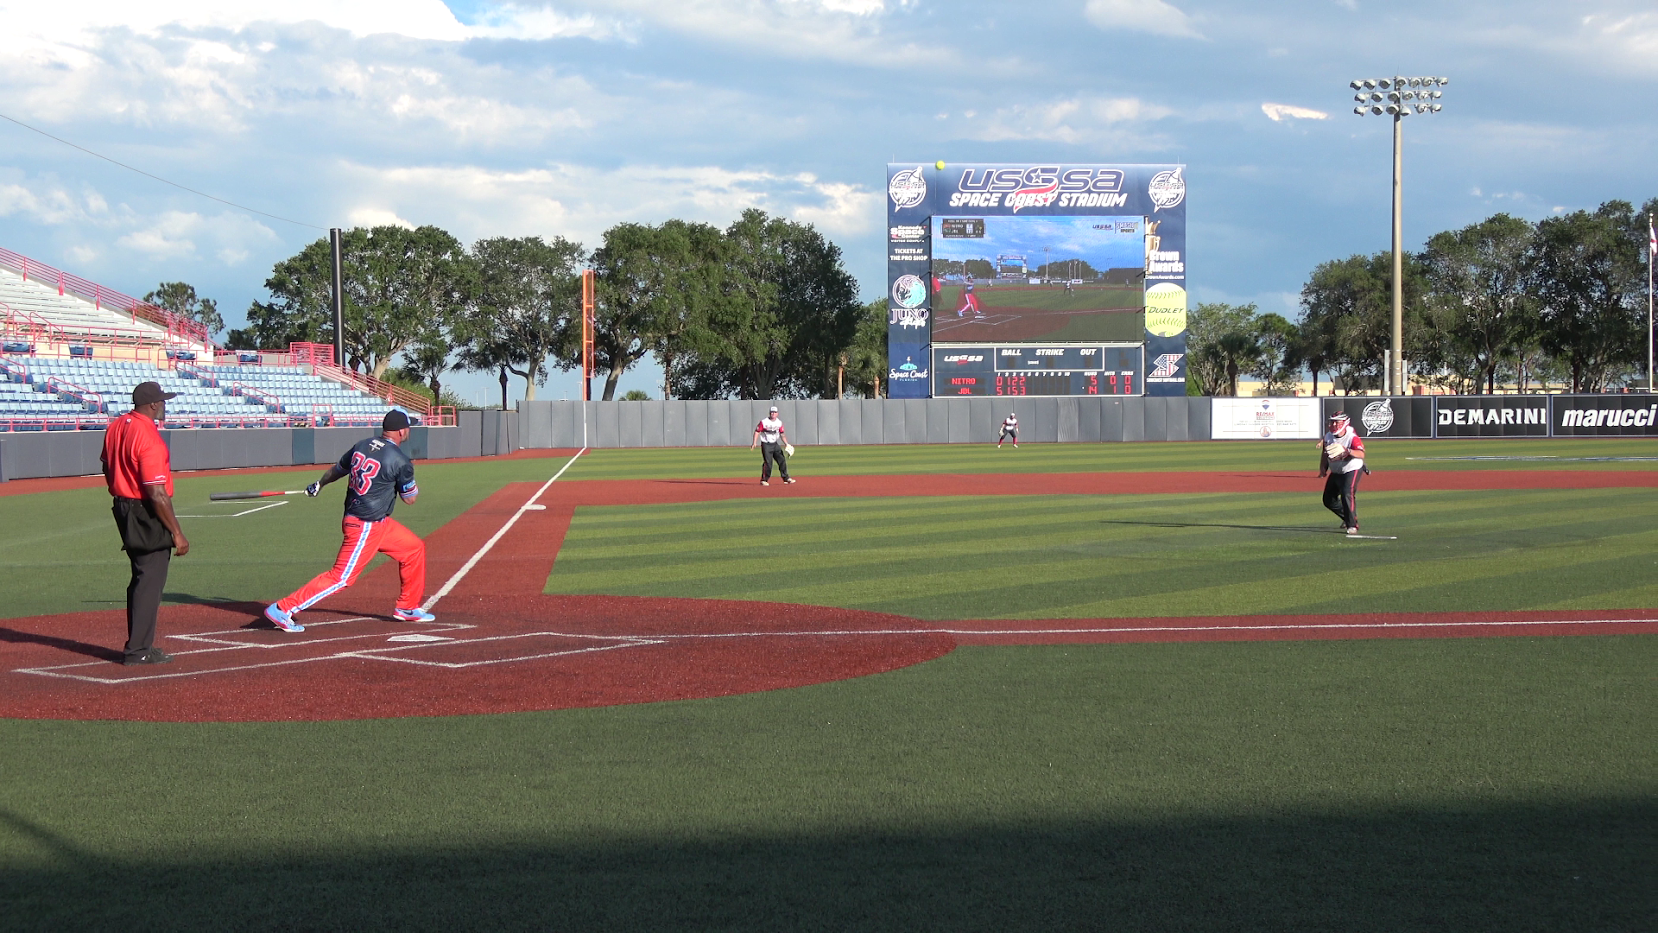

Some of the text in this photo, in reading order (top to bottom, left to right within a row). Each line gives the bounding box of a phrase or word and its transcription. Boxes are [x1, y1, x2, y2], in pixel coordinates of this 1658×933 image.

[949, 192, 1128, 207] SPACE COAST STADIUM
[1149, 260, 1184, 272] Awards
[890, 308, 928, 324] JUNO
[889, 368, 928, 380] Space Coast
[996, 376, 1002, 386] 0
[1110, 376, 1117, 385] 0
[1124, 376, 1132, 385] 0
[1438, 408, 1546, 425] DEMARINI
[1562, 404, 1657, 427] marucci
[350, 451, 381, 496] 33
